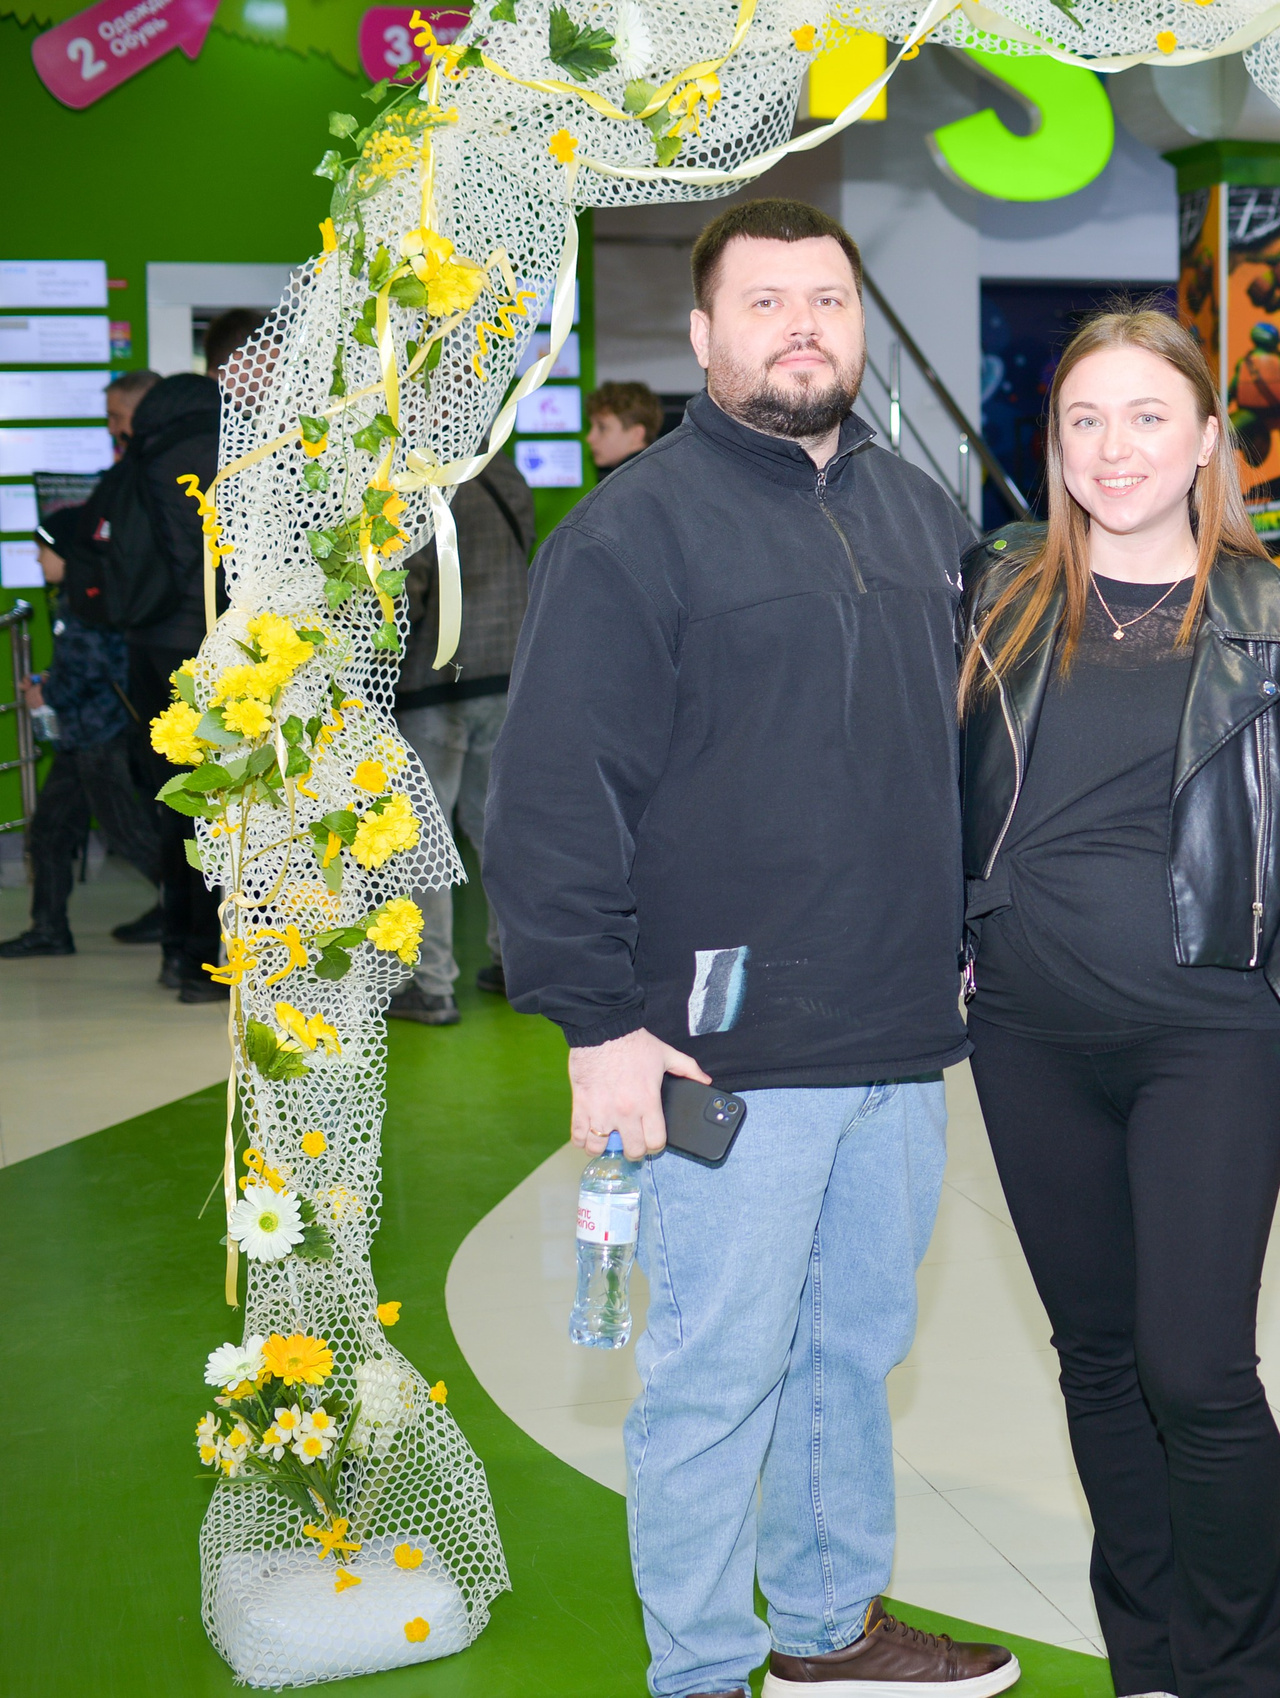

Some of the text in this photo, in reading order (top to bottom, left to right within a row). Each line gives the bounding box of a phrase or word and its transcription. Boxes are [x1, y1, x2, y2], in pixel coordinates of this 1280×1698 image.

[66, 37, 107, 81] 2
[109, 18, 169, 57] Обувь
[382, 25, 414, 68] 3
